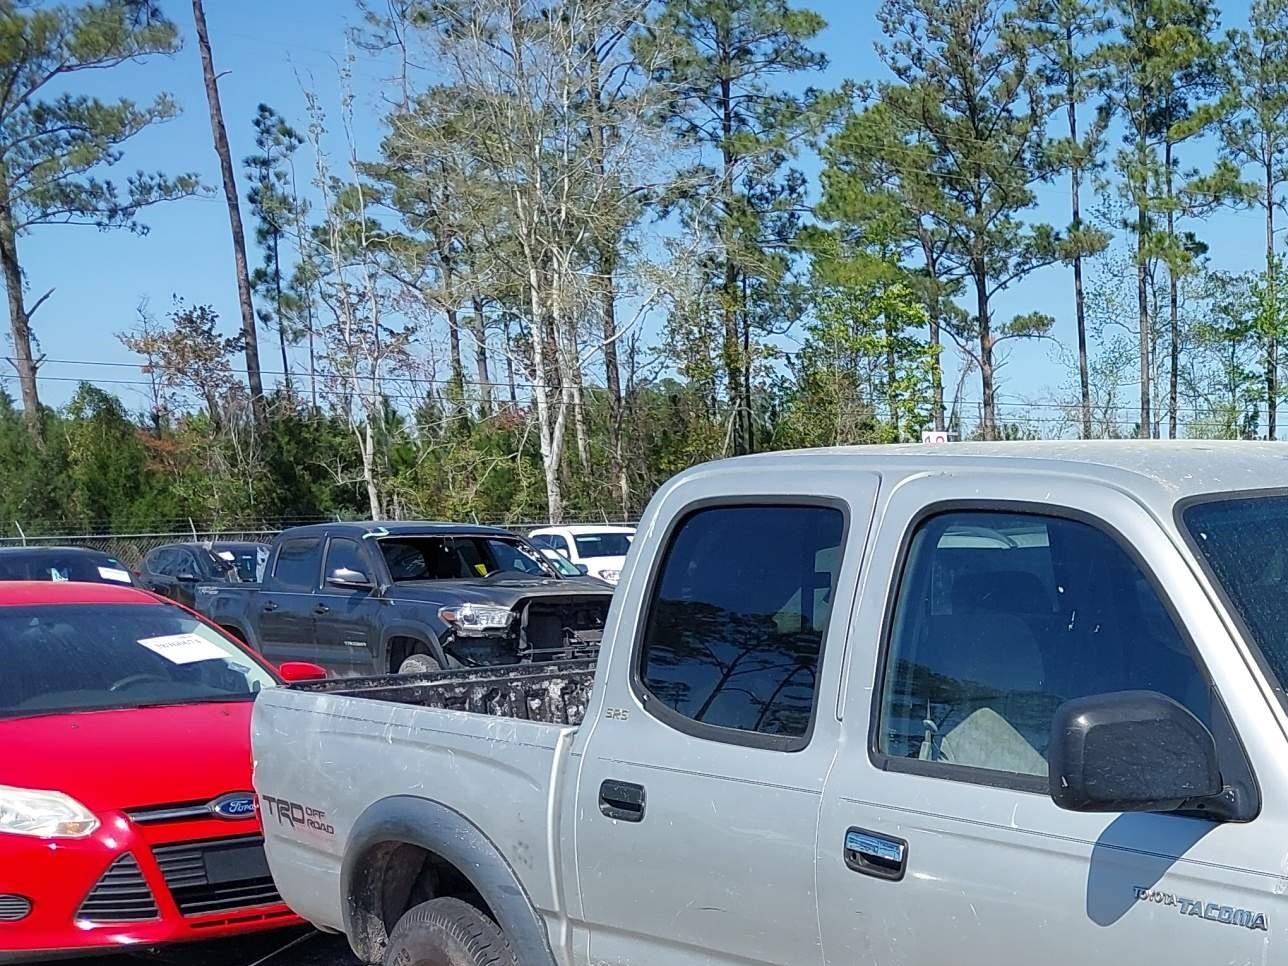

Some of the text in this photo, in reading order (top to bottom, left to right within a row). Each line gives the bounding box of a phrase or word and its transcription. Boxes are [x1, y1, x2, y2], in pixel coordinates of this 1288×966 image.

[605, 707, 630, 721] SRS
[262, 795, 335, 835] TRD OFF ROAD
[1133, 885, 1269, 931] TOYOTA TACOMA
